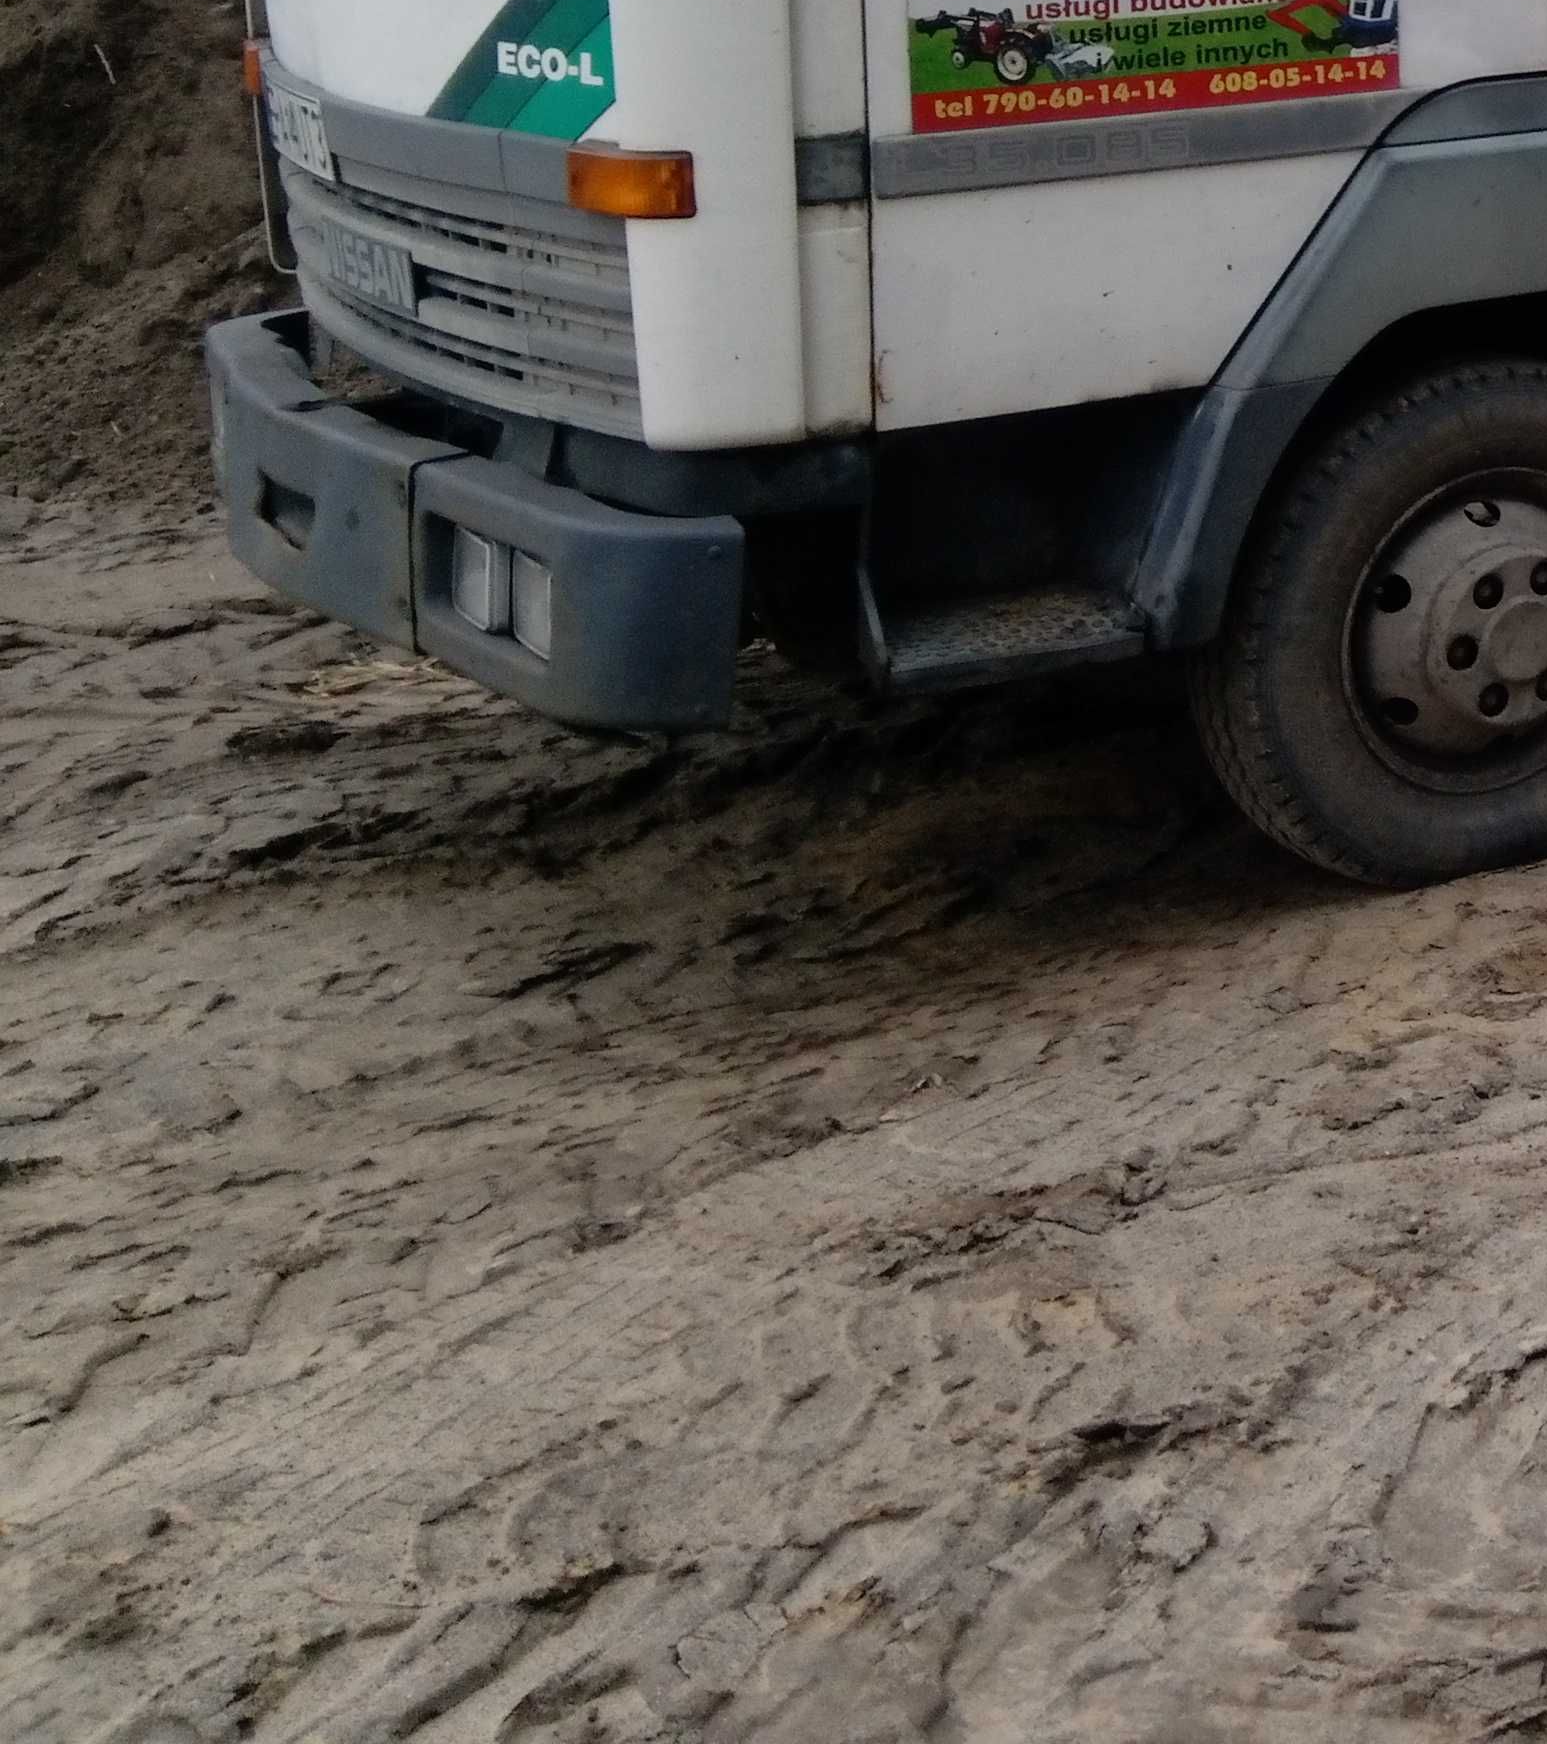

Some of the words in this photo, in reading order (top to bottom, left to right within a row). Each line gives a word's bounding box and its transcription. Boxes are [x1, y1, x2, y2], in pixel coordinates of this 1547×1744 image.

[1069, 18, 1158, 45] usługi
[1167, 14, 1267, 37] ziemne
[496, 40, 604, 86] ECO-L
[1110, 49, 1186, 71] wiele
[1197, 37, 1289, 65] innych
[934, 95, 974, 119] tel
[983, 78, 1177, 115] 790-60-14-14
[1208, 59, 1387, 94] 608-05-14-14
